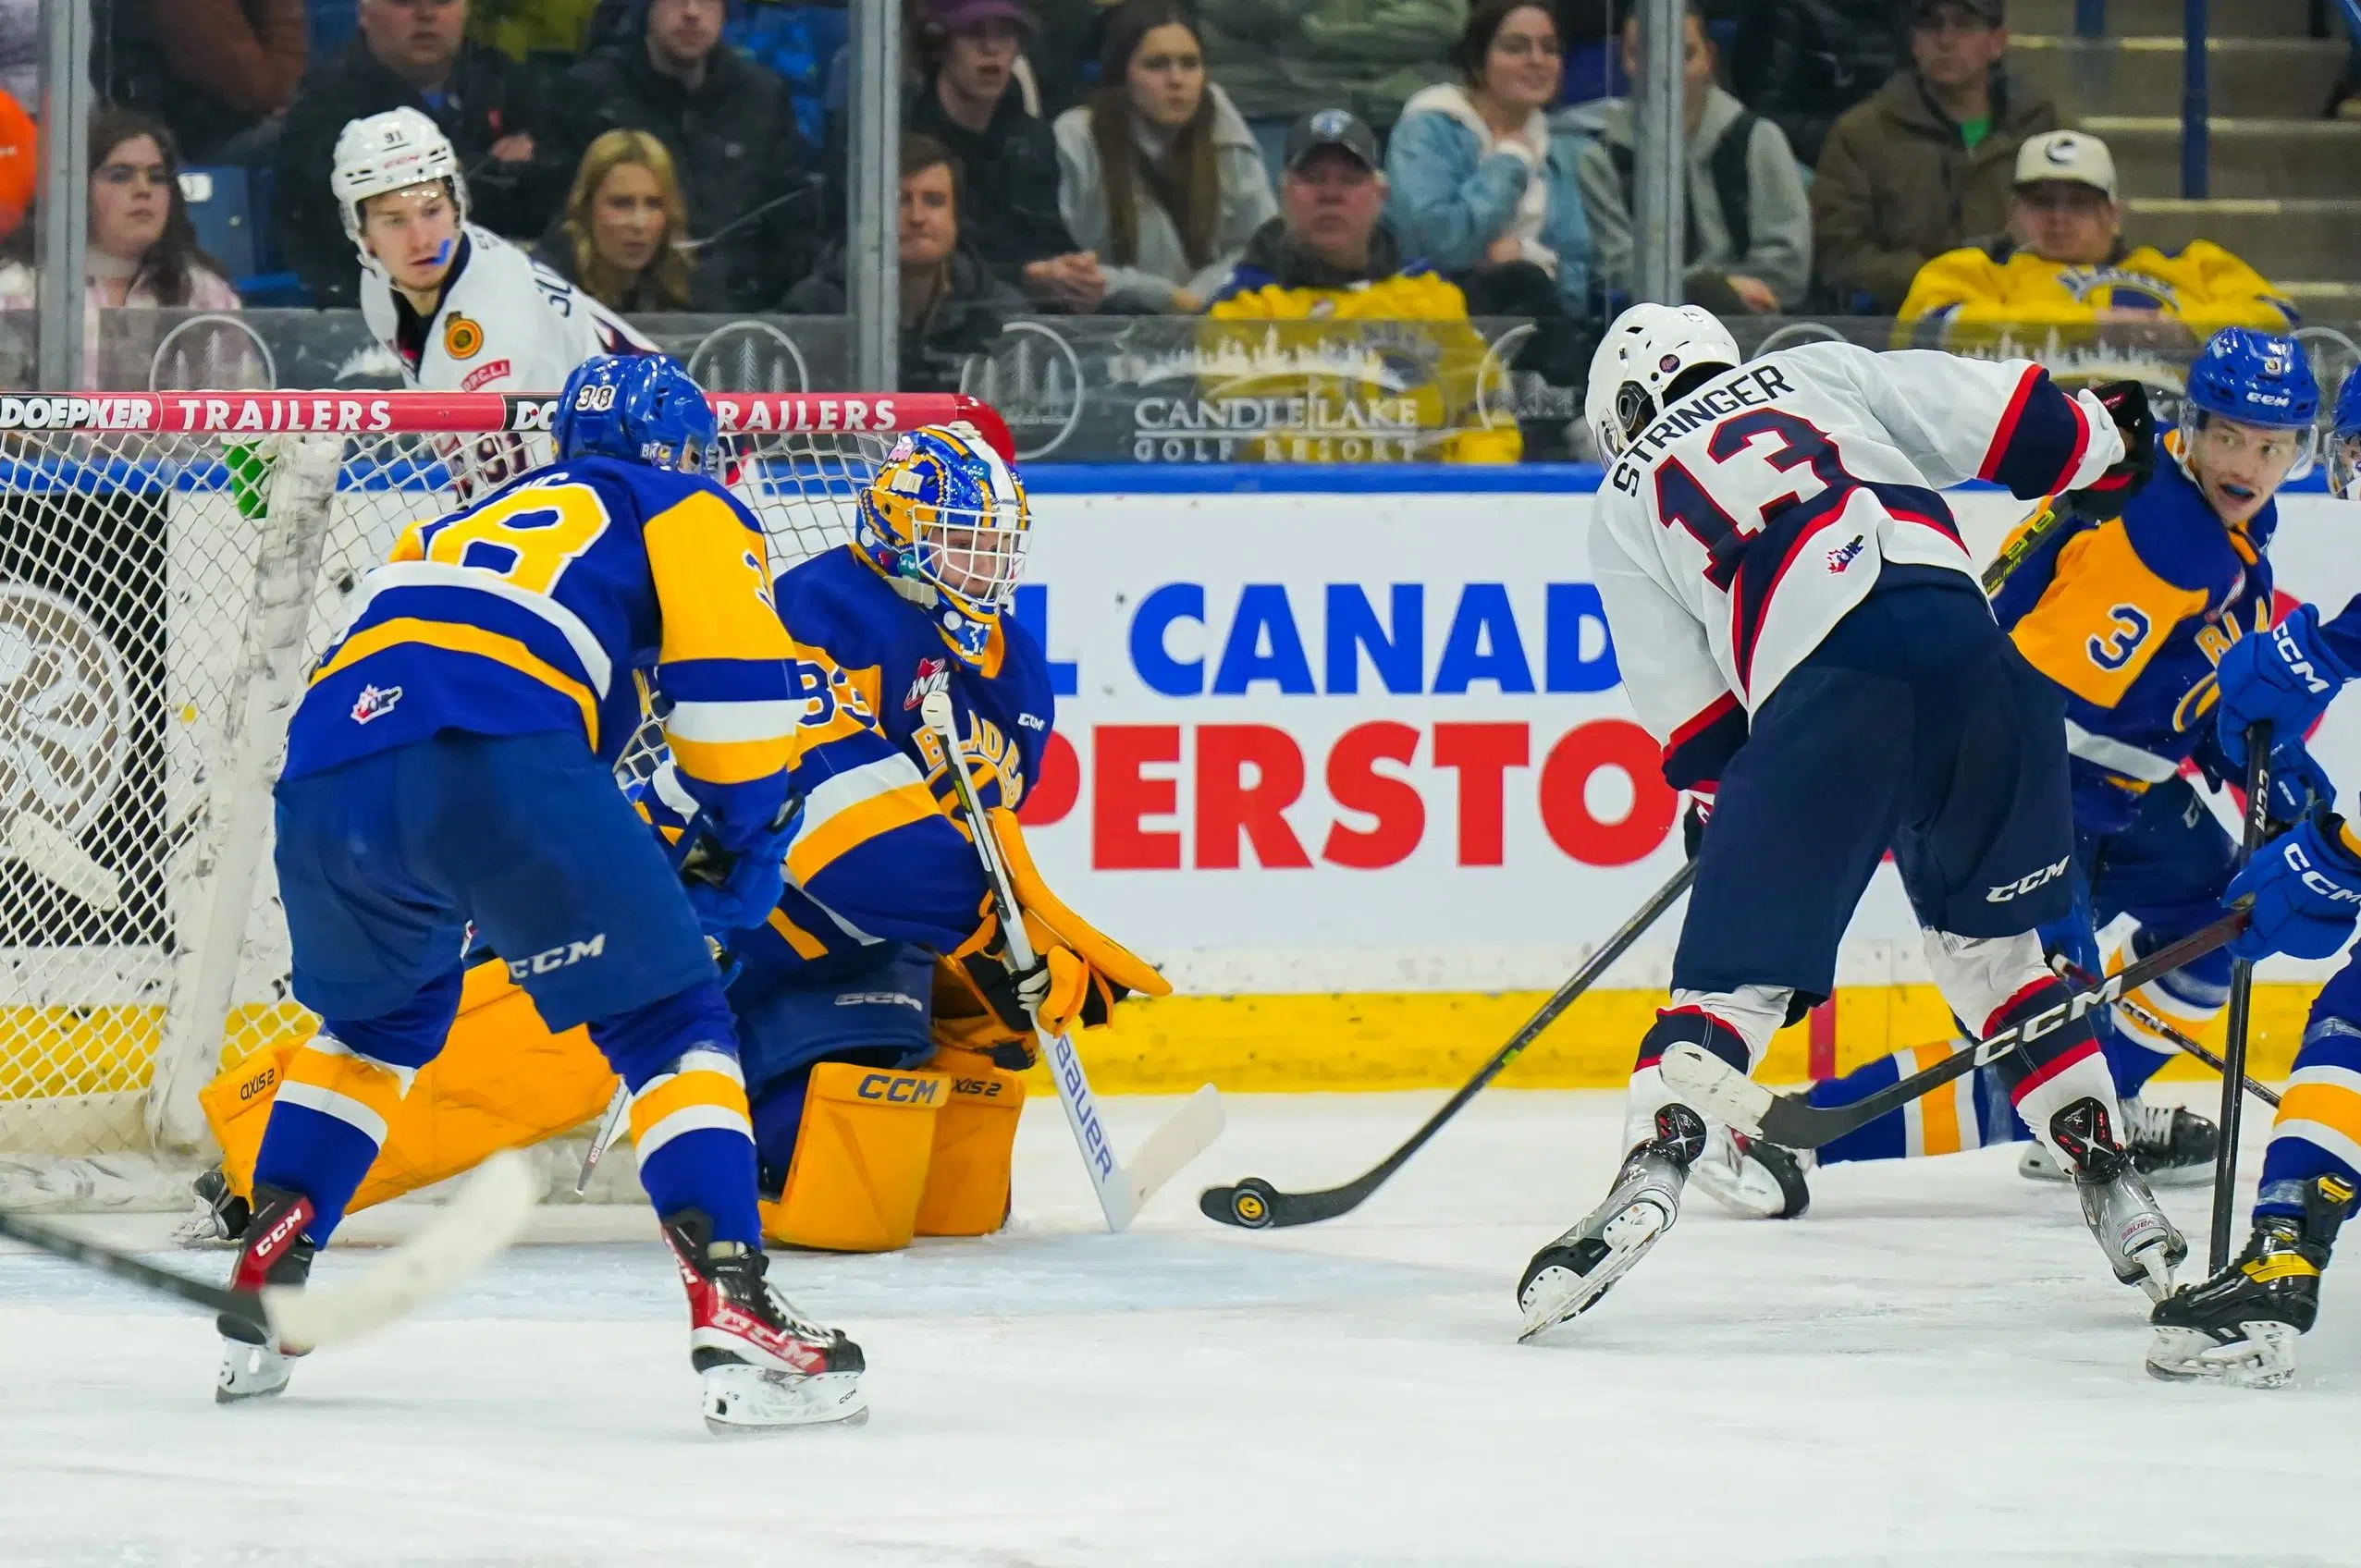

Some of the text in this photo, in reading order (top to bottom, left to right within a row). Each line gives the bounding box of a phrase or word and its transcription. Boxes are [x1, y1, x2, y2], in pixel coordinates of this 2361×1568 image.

[0, 398, 393, 432] DOEPKER TRAILERS
[716, 398, 896, 432] RAILERS
[1134, 398, 1419, 429] CANDLE LAKE
[2245, 392, 2291, 408] CCM
[1134, 438, 1420, 462] GOLF RESORT
[1613, 365, 1794, 496] STRINGER
[1653, 407, 1859, 594] 13
[2085, 602, 2152, 673] 3
[2272, 620, 2330, 693] CCM
[910, 709, 1024, 810] BADES
[2255, 769, 2270, 832] CCM
[1986, 854, 2071, 903] CCM
[2284, 842, 2361, 903] CCM
[509, 933, 607, 980] CCM
[834, 992, 923, 1012] CCM
[1973, 974, 2123, 1068] CCM
[857, 1073, 940, 1105] CCM
[255, 1207, 302, 1257] CCM
[710, 1307, 820, 1370] CCM
[839, 1388, 856, 1405] CCM
